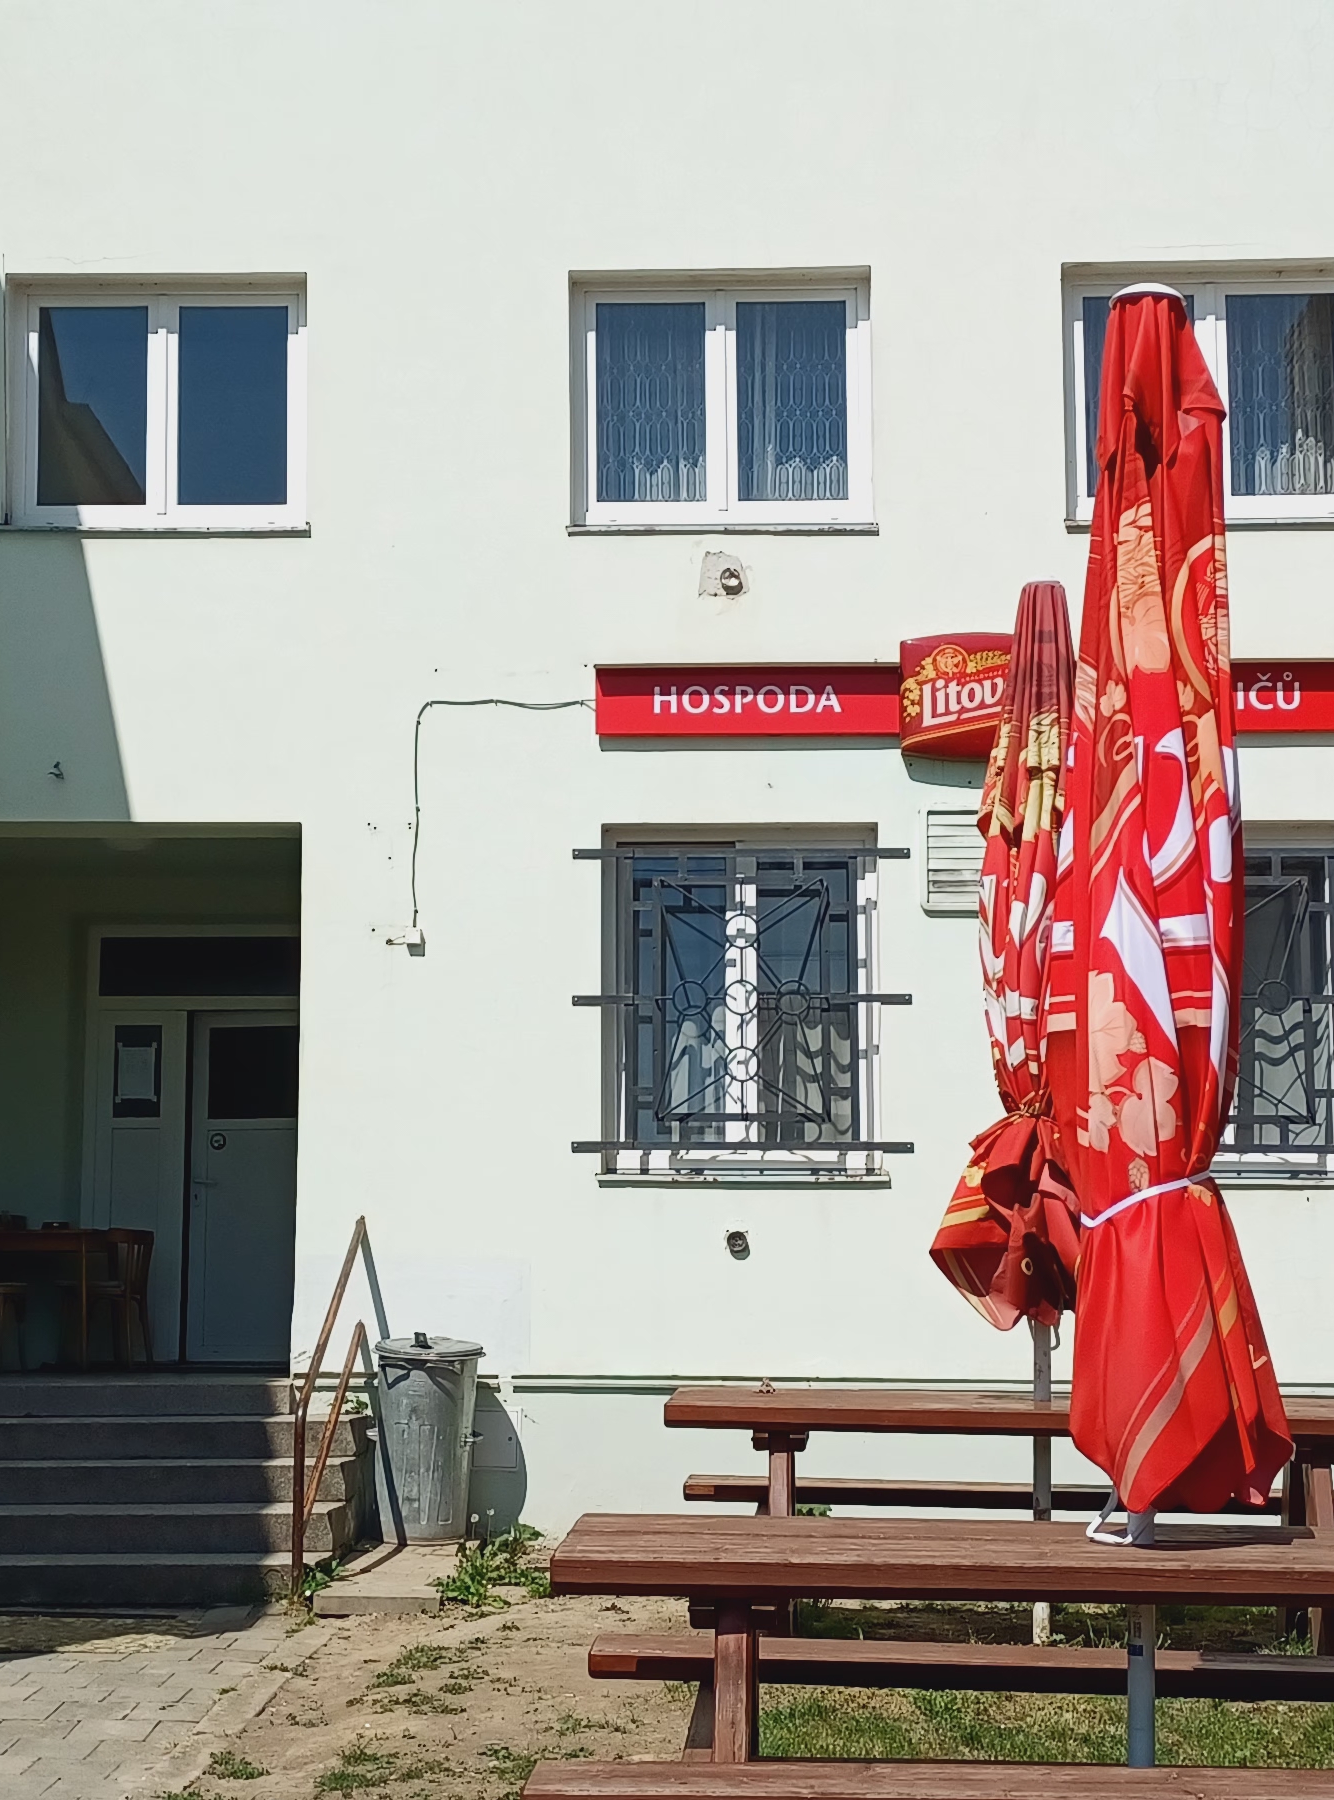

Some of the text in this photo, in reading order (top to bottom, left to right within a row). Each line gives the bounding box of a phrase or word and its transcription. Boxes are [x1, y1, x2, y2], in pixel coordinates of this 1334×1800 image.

[653, 671, 1301, 714] HOSPODA IČŮ
[921, 678, 1005, 728] Litov
